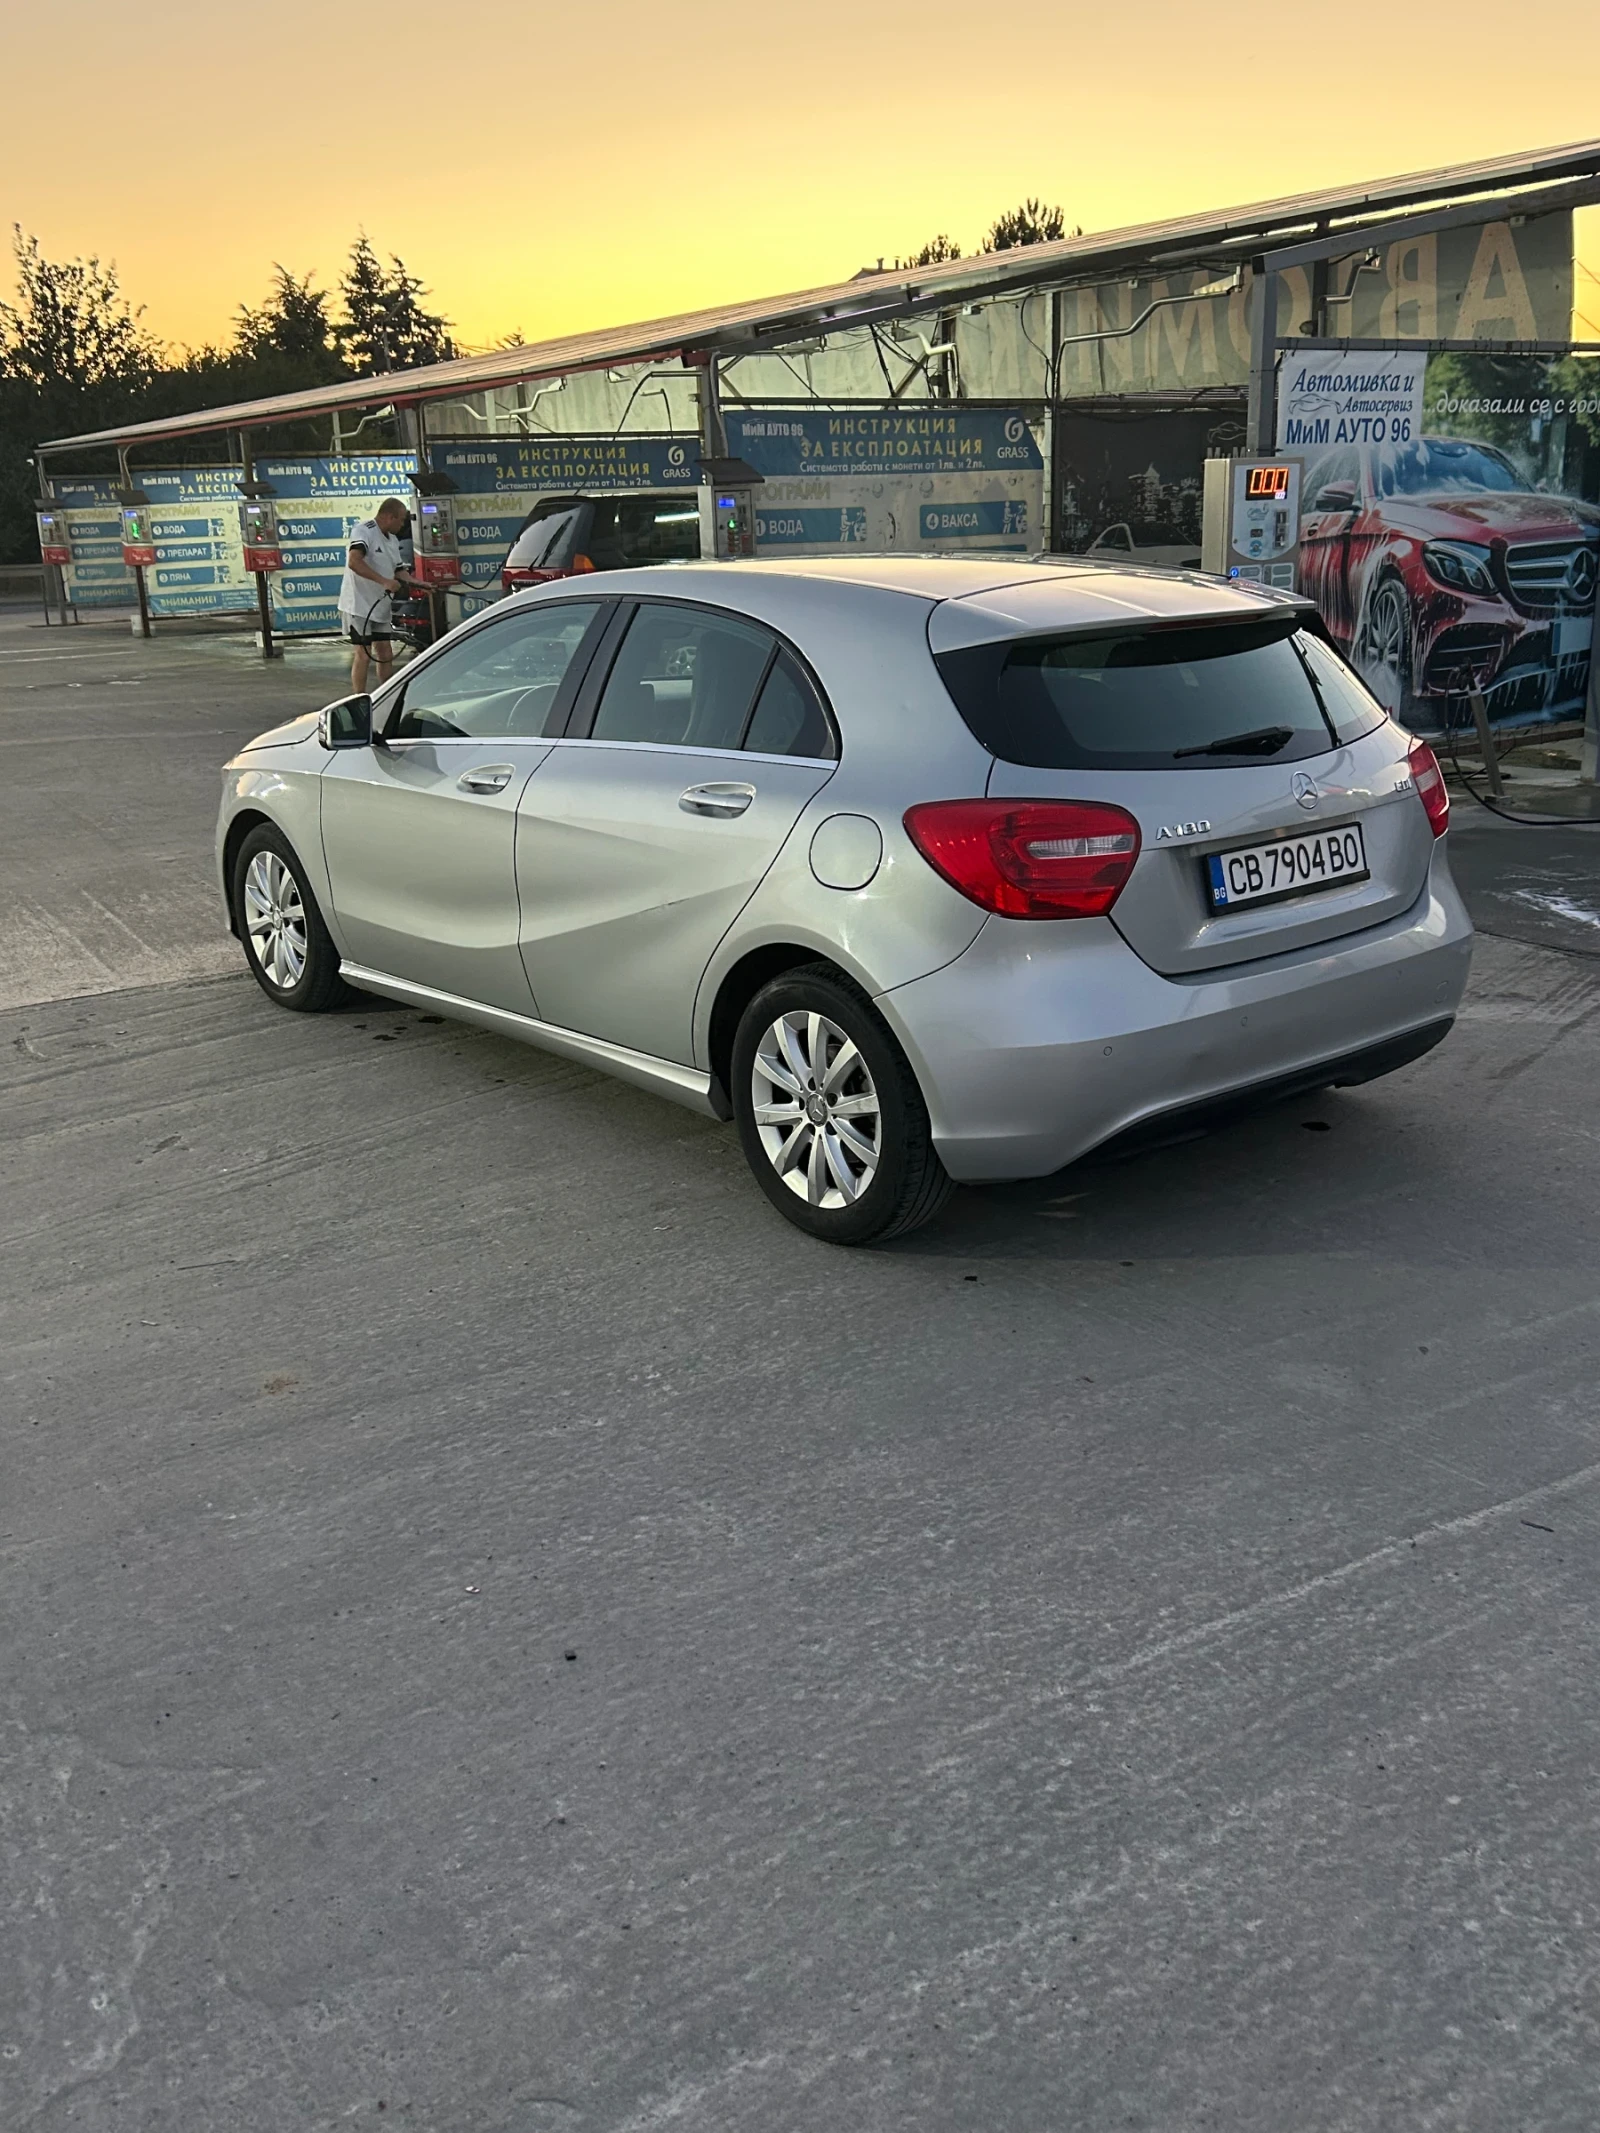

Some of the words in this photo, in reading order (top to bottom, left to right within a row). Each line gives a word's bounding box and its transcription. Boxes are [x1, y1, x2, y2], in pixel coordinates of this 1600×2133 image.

[1291, 368, 1400, 392] Автомивка
[1403, 375, 1415, 393] и
[1343, 397, 1413, 417] Автосервиз
[1530, 398, 1550, 414] се
[1554, 398, 1565, 413] с
[742, 424, 765, 436] МиМ
[766, 423, 790, 436] АУТО
[791, 423, 804, 436] 96
[829, 418, 956, 435] ИНСТРУКЦИЯ
[1286, 418, 1330, 444] МиМ
[1334, 418, 1386, 443] АУТО
[1391, 417, 1411, 443] 96
[801, 441, 824, 457] ЗА
[832, 439, 982, 457] ЕКСПЛОАТАЦИЯ
[997, 447, 1029, 459] GRASS
[446, 454, 466, 465] МиМ
[467, 454, 485, 464] АУТО
[486, 453, 498, 463] 96
[518, 447, 626, 462] ИНСТРУКЦИЯ
[329, 460, 415, 474] ИНСТРУКЦИ
[496, 466, 516, 479] ЗА
[521, 463, 650, 478] ЕКСПЛОАТАЦИЯ
[662, 468, 691, 478] GRASS
[800, 462, 848, 473] Системата
[851, 460, 882, 474] работи
[892, 463, 923, 471] монети
[925, 462, 935, 470] от
[195, 472, 243, 483] ИНСТРУ
[310, 476, 328, 487] ЗА
[179, 485, 195, 494] ЗА
[496, 481, 537, 490] Системата
[539, 480, 565, 492] работи
[941, 513, 979, 528] ВАКСА
[163, 525, 186, 535] ВОДА
[291, 524, 317, 536] ВОДА
[472, 526, 502, 539] ВОДА
[769, 520, 804, 537] ВОДА
[167, 547, 207, 557] ПРЕПАРАТ
[295, 552, 341, 563] ПРЕПАРАТ
[169, 573, 192, 581] ПЯНА
[297, 582, 322, 592] ПЯНА
[160, 595, 217, 607] ВНИМАНИЕ!
[286, 611, 341, 623] ВНИМАНИ
[1214, 887, 1226, 899] BG
